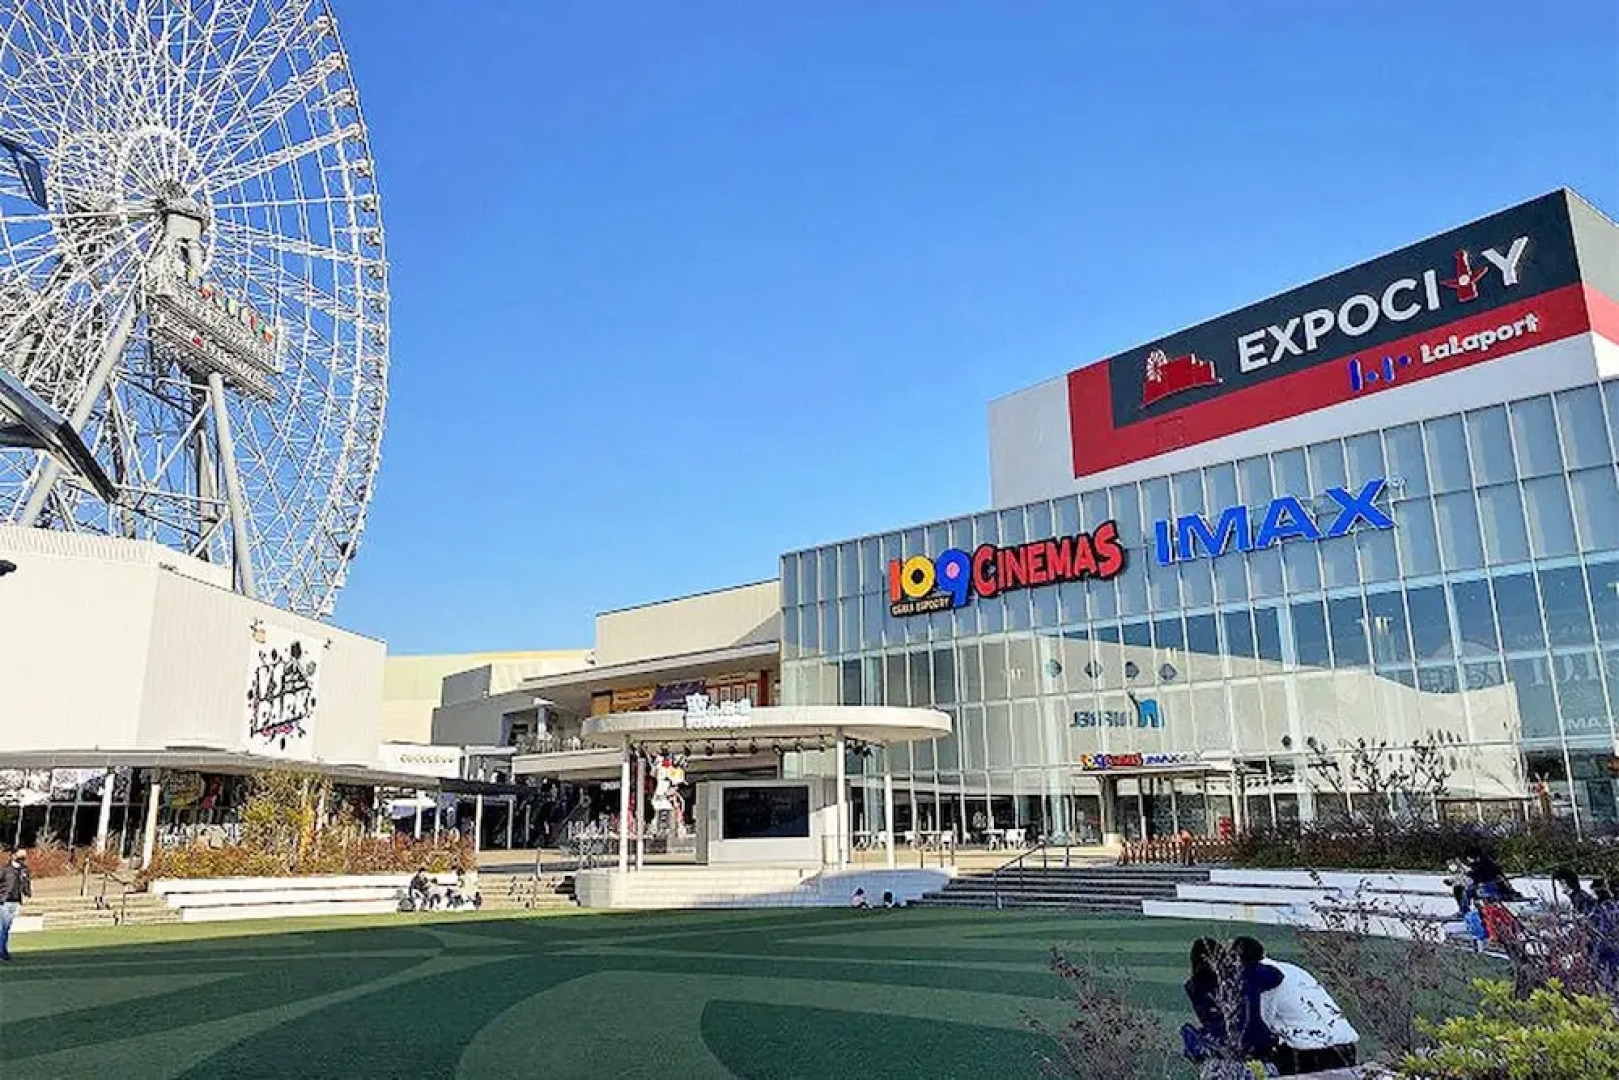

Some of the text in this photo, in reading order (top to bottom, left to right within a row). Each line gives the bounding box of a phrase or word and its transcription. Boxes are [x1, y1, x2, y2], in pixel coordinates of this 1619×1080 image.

[1420, 313, 1539, 364] LaLaport
[1154, 478, 1396, 566] IMAX
[889, 521, 1124, 609] 109 CINEMAS
[256, 689, 309, 728] PARK
